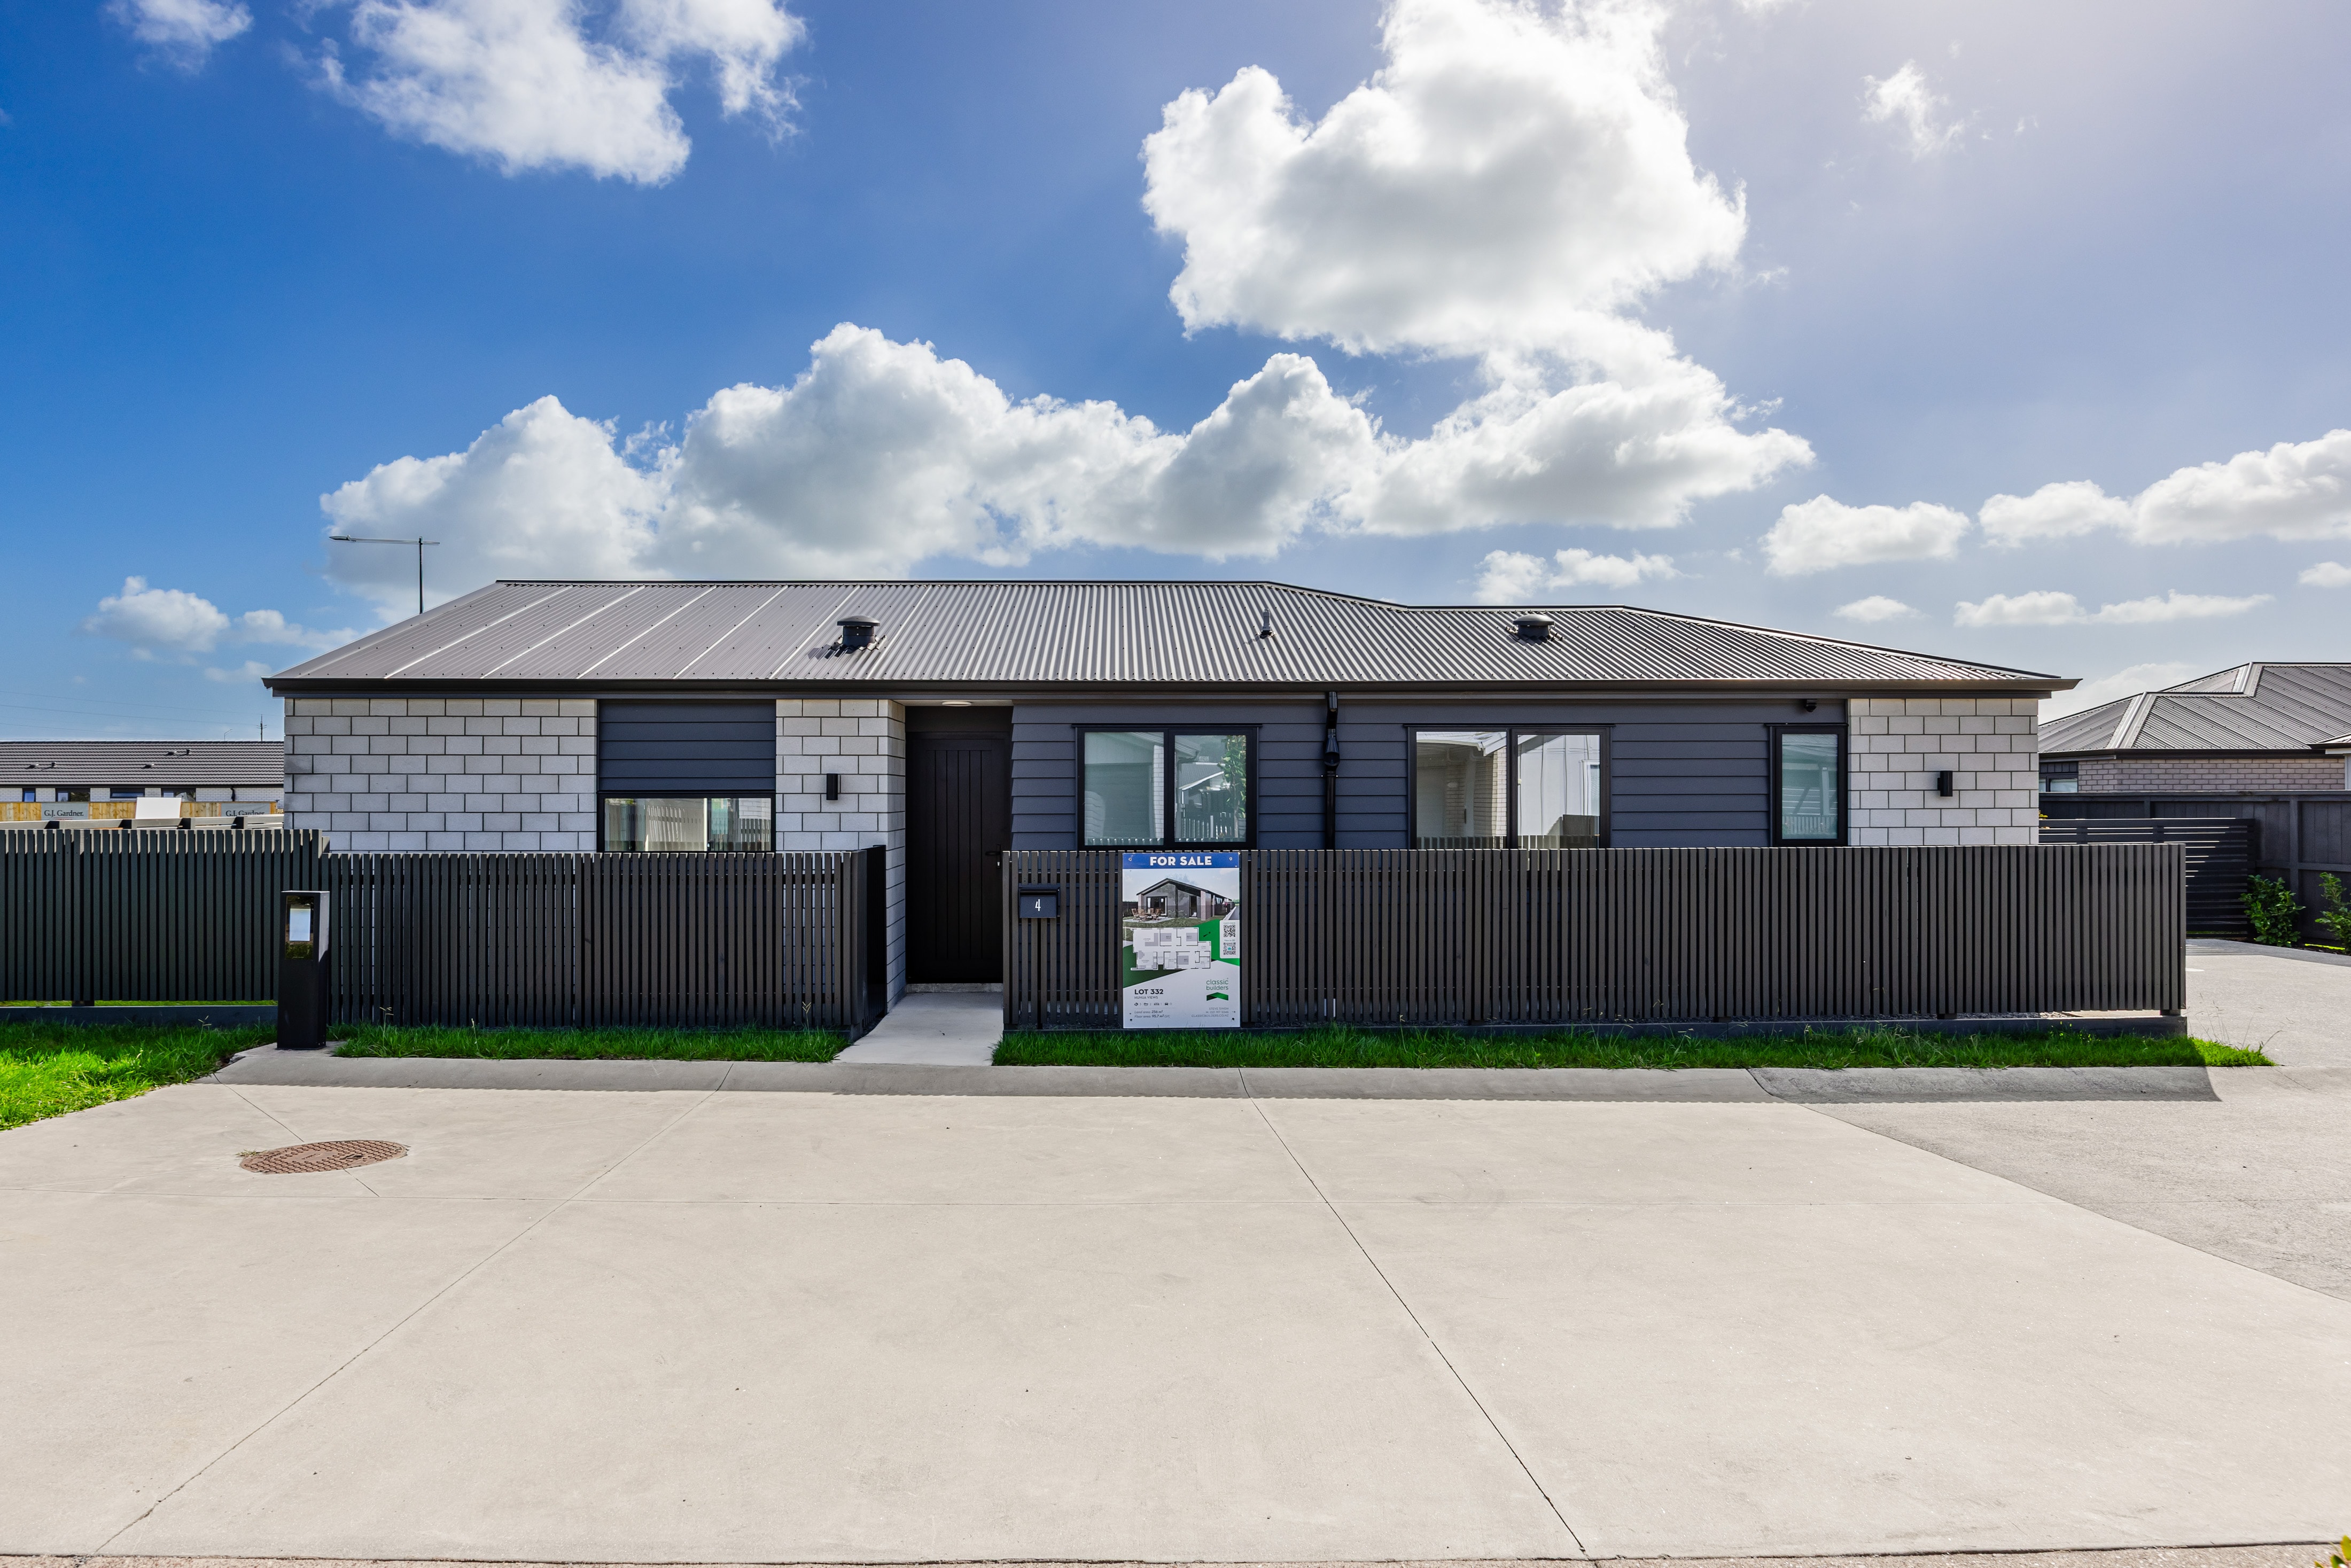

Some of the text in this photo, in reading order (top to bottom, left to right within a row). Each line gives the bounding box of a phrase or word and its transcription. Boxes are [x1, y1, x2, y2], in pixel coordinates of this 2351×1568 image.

[44, 809, 56, 817] G.J.
[1150, 856, 1212, 865] FOR SALE
[1034, 899, 1041, 911] 4
